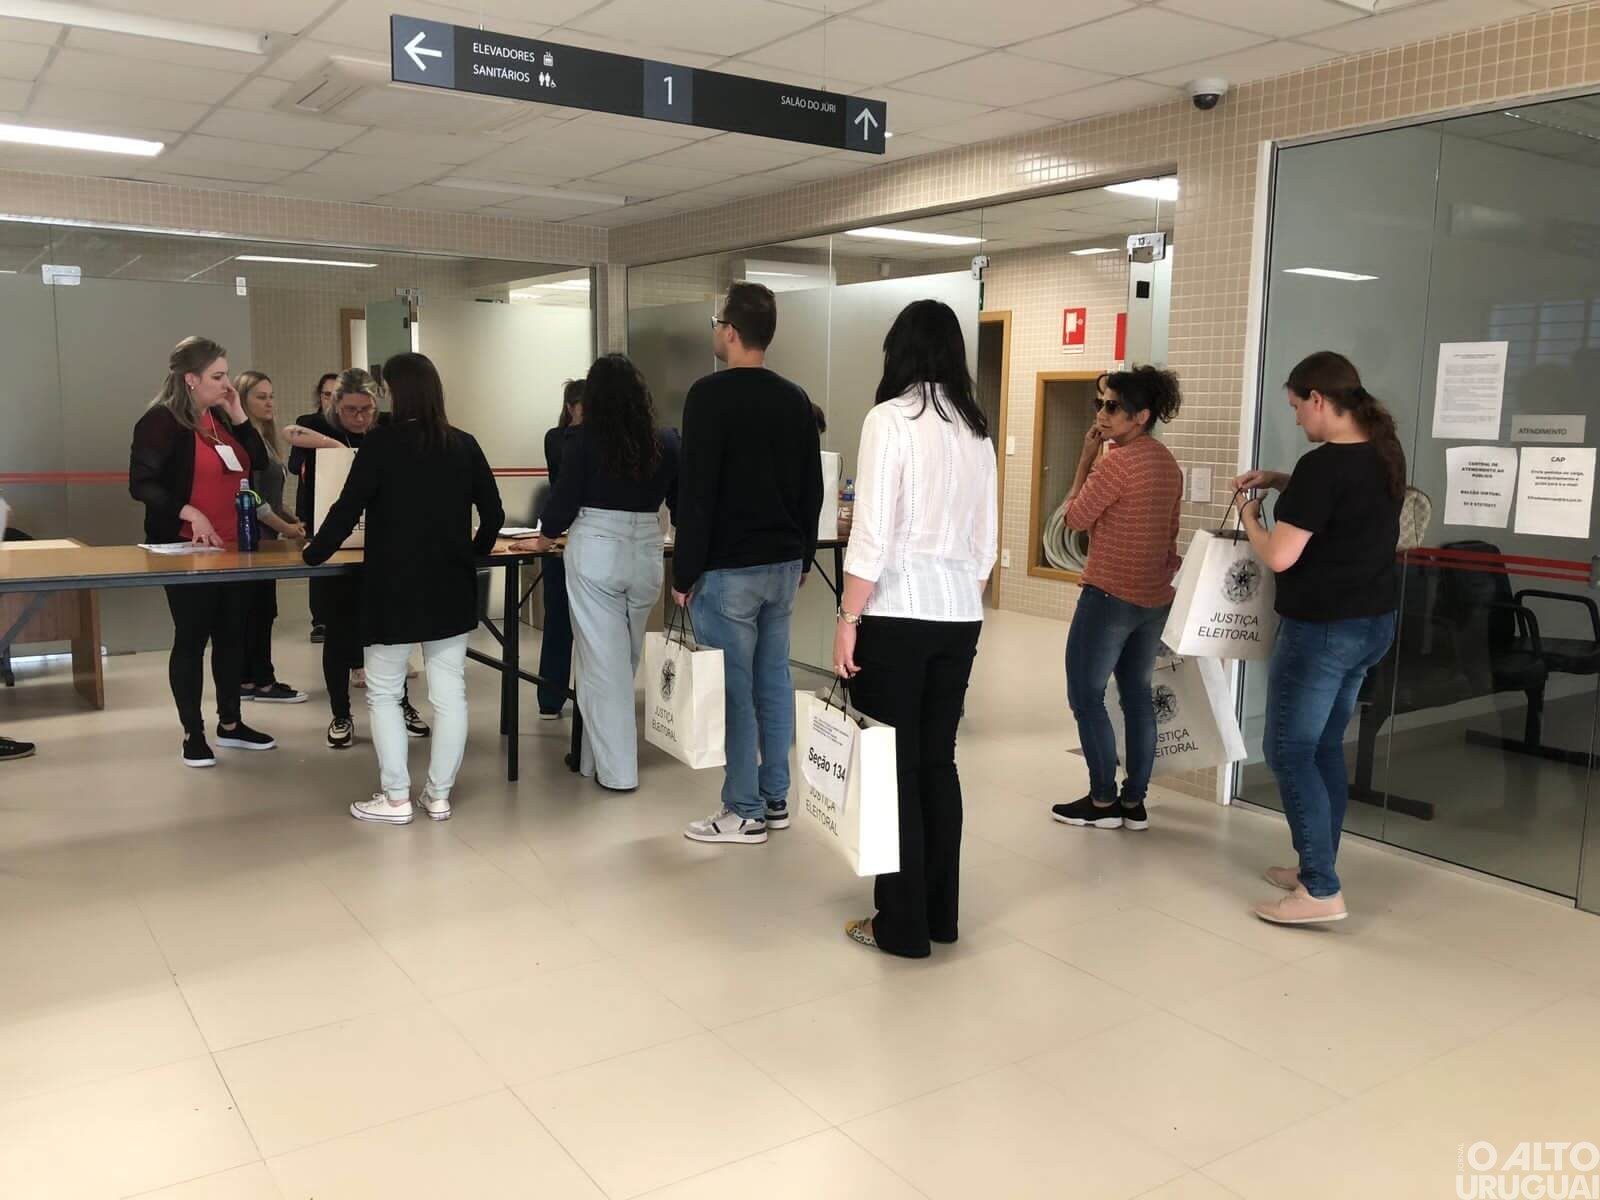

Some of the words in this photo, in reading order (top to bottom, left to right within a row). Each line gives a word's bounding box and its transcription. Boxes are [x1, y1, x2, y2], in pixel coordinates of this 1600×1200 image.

[473, 42, 535, 62] ELEVADORES
[473, 64, 530, 83] SANITÁRIOS
[663, 76, 673, 105] 1
[807, 99, 820, 111] DO
[1518, 427, 1567, 436] ATENDIMENTO
[1210, 611, 1258, 627] JUSTIÇA
[1198, 626, 1261, 642] ELEITORAL
[655, 705, 674, 724] JUSTIÇA
[652, 719, 677, 742] ELEITORAL
[1158, 728, 1190, 743] STIÇA
[1154, 741, 1199, 758] EITORAL
[808, 746, 831, 772] Seção
[832, 763, 846, 782] 134
[805, 799, 839, 837] ELEITORAL
